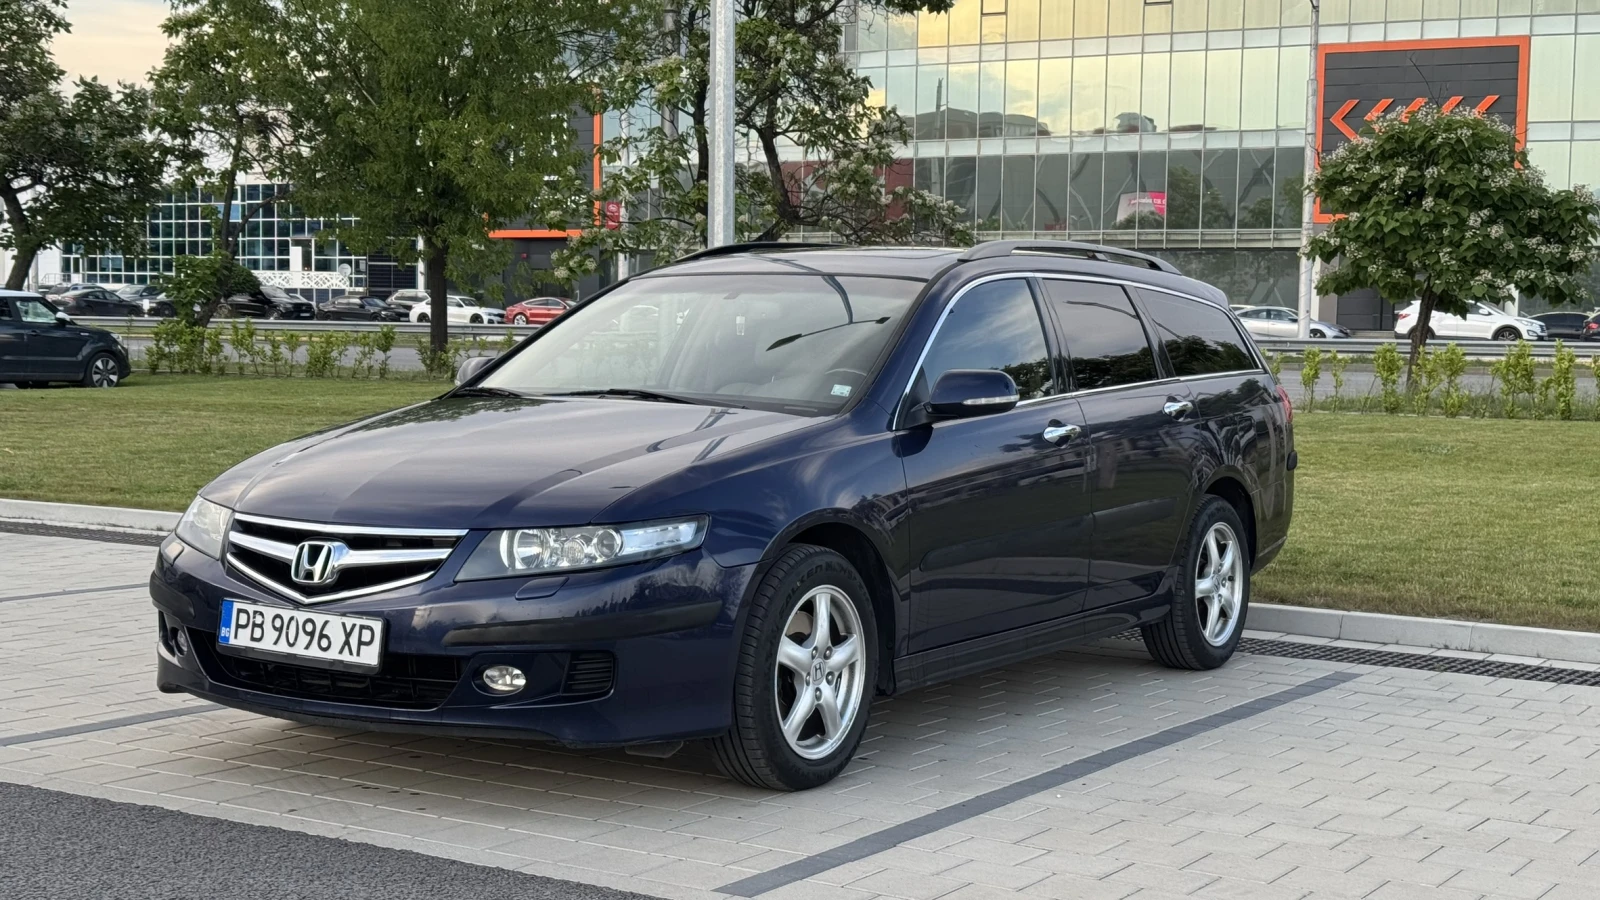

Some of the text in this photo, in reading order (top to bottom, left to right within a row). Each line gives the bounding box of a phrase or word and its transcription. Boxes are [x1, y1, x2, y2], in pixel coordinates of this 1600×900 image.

[220, 627, 230, 638] BG
[233, 607, 375, 657] PB 9096 XP
